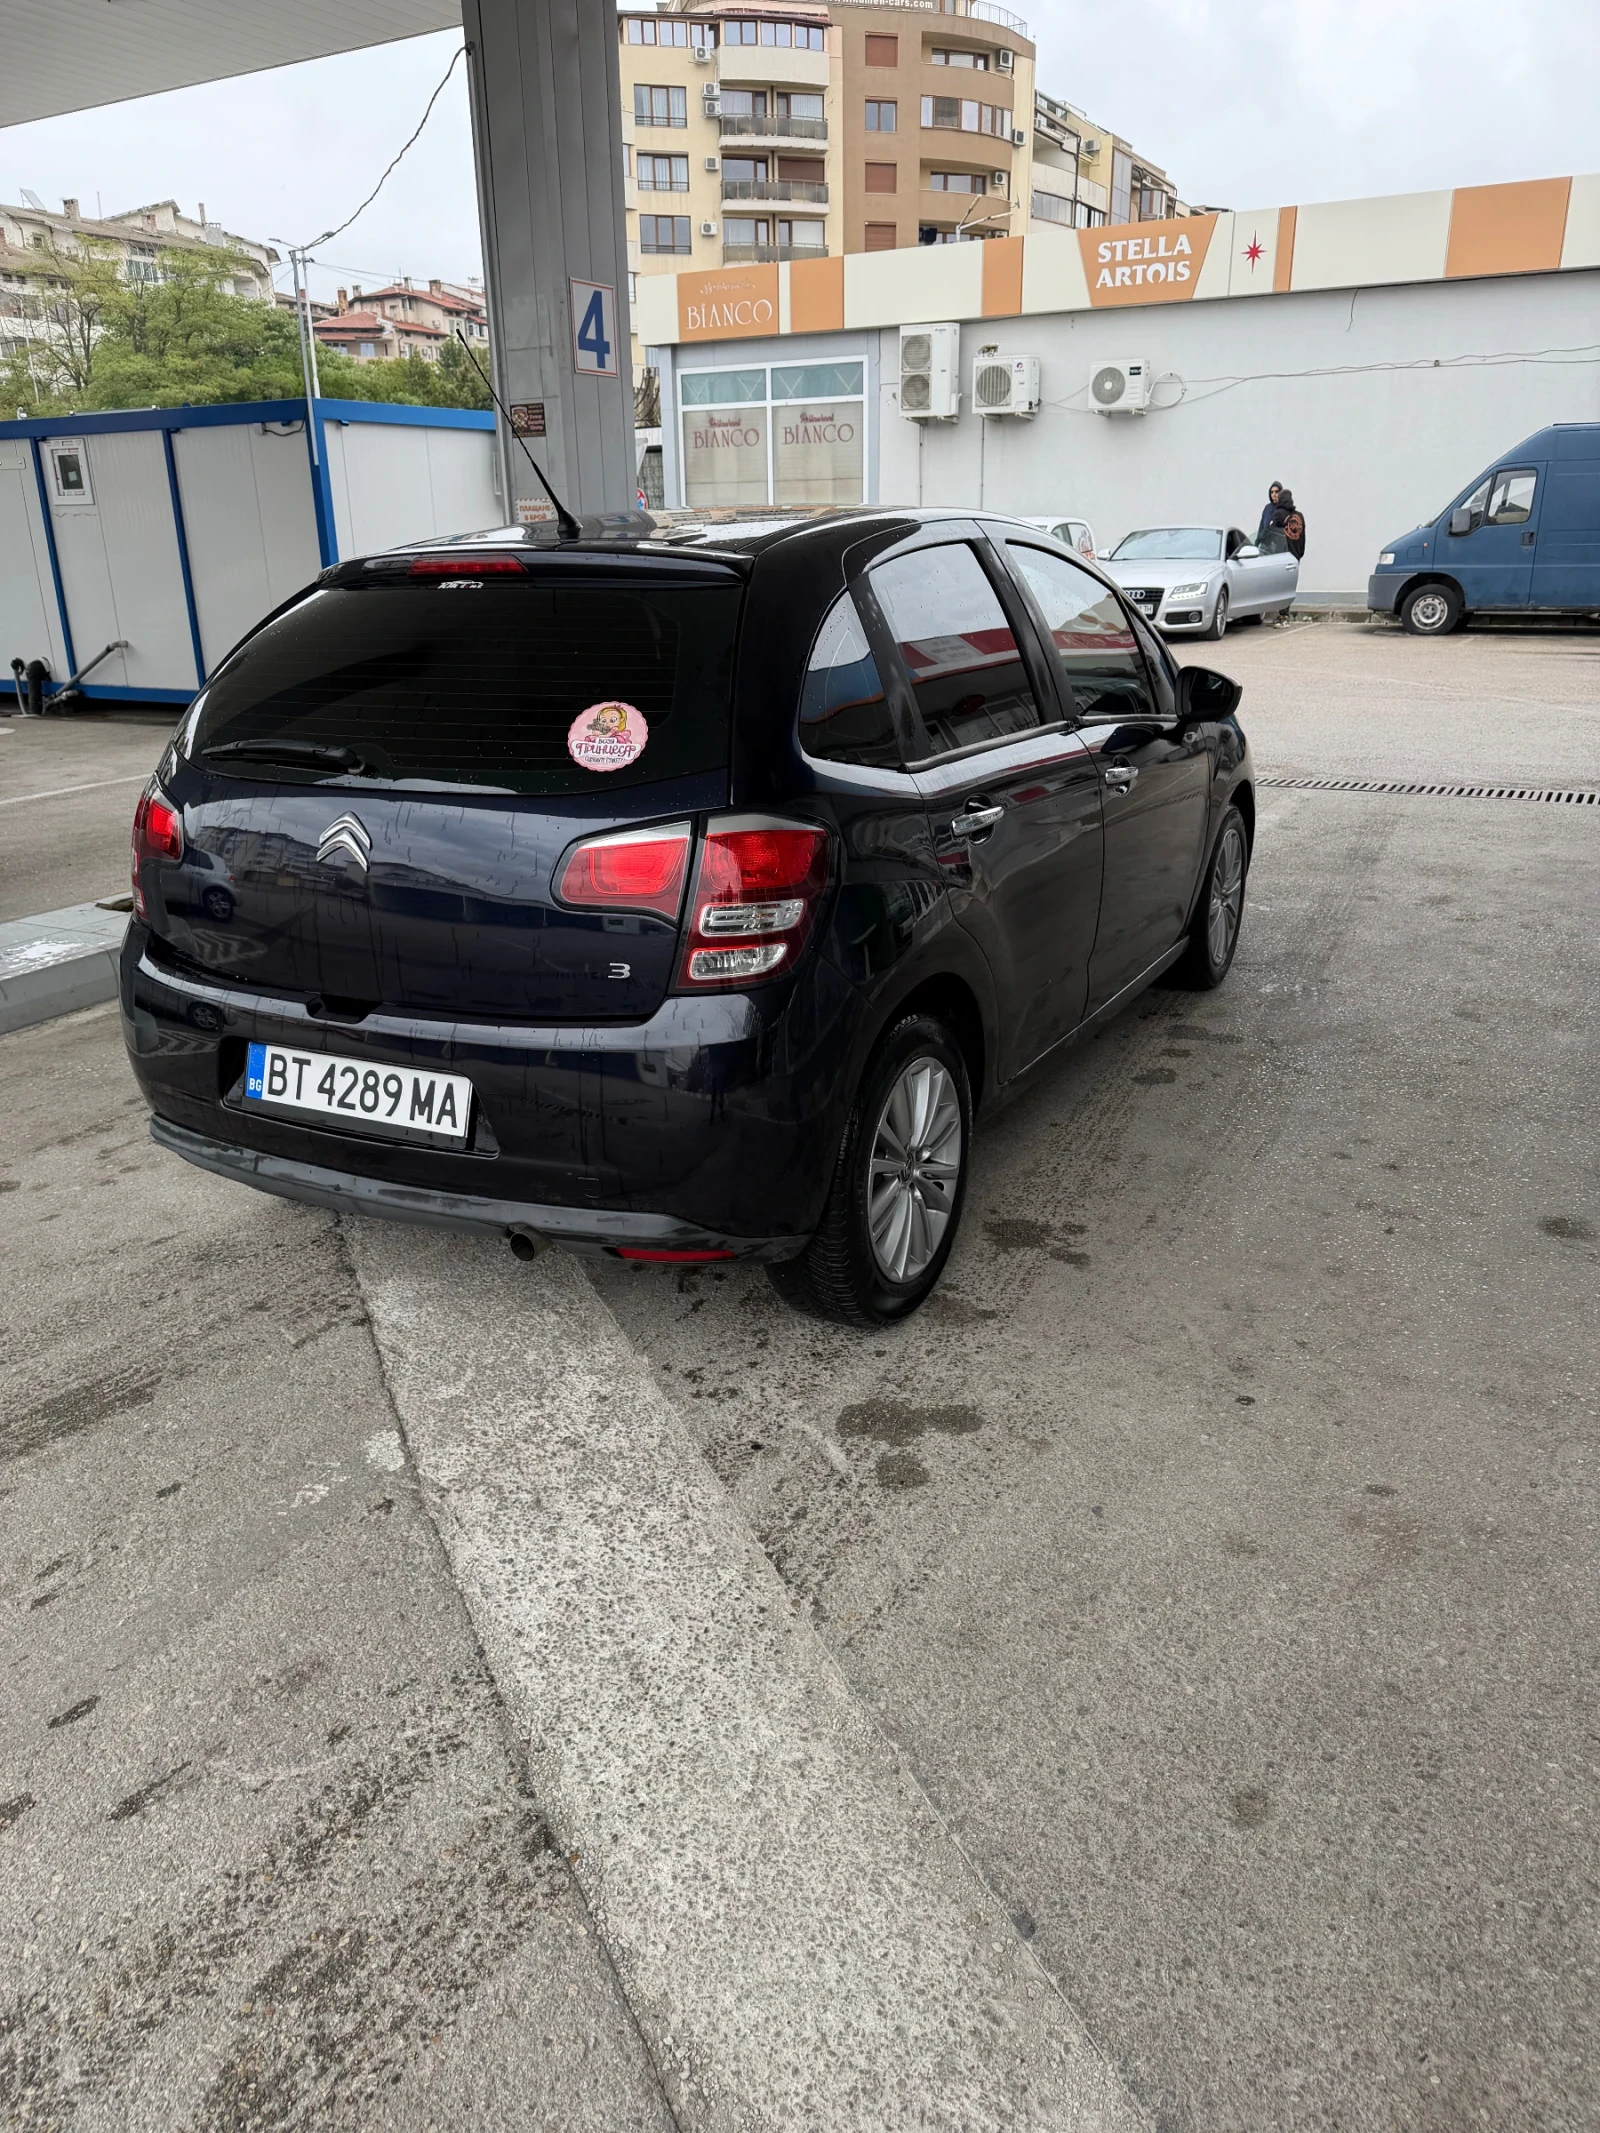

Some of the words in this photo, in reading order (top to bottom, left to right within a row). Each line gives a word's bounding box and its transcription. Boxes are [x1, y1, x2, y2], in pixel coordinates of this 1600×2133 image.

[1097, 234, 1193, 263] STELLA
[1095, 260, 1191, 289] ARTOIS
[687, 298, 773, 330] BIANCO
[577, 290, 611, 369] 4
[693, 427, 760, 449] BIANCO
[783, 422, 855, 446] BIANCO
[519, 504, 551, 512] ПЛАЩАНЕ
[607, 962, 631, 979] 3
[248, 1077, 262, 1092] BG
[267, 1053, 312, 1101] BT
[316, 1063, 403, 1117] 4289
[409, 1077, 458, 1129] MA
